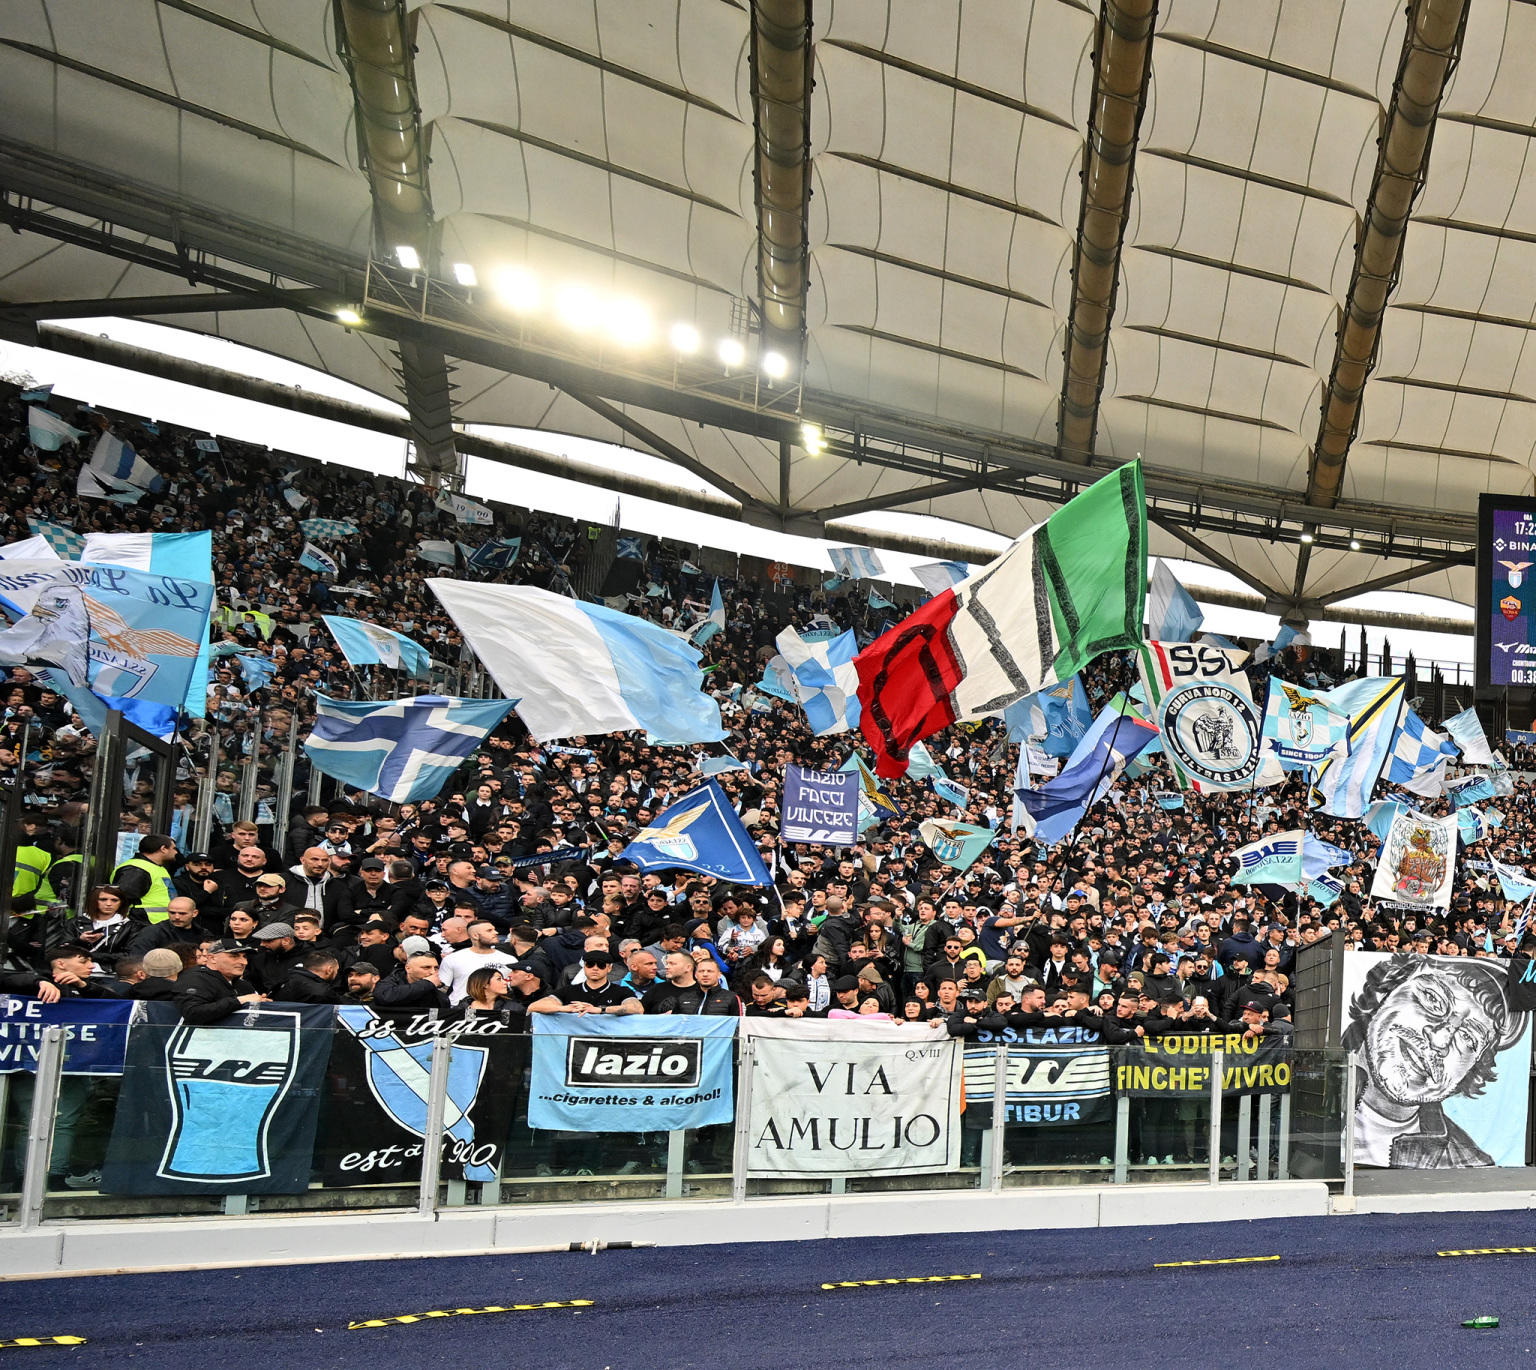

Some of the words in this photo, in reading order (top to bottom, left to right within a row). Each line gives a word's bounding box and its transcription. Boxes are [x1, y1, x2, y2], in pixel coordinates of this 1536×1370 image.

[1168, 688, 1203, 716] CURVA
[1281, 750, 1303, 758] SINCE
[800, 768, 846, 786] LAZIO
[798, 786, 845, 806] FACCI
[786, 806, 853, 827] VINCERE
[0, 1023, 98, 1042] NTISE
[578, 1046, 690, 1076] lazio
[806, 1061, 893, 1096] VIA
[643, 1095, 656, 1106] &
[660, 1088, 721, 1106] alcohol!
[1001, 1102, 1080, 1122] TIBUR
[755, 1114, 940, 1152] AMULIO
